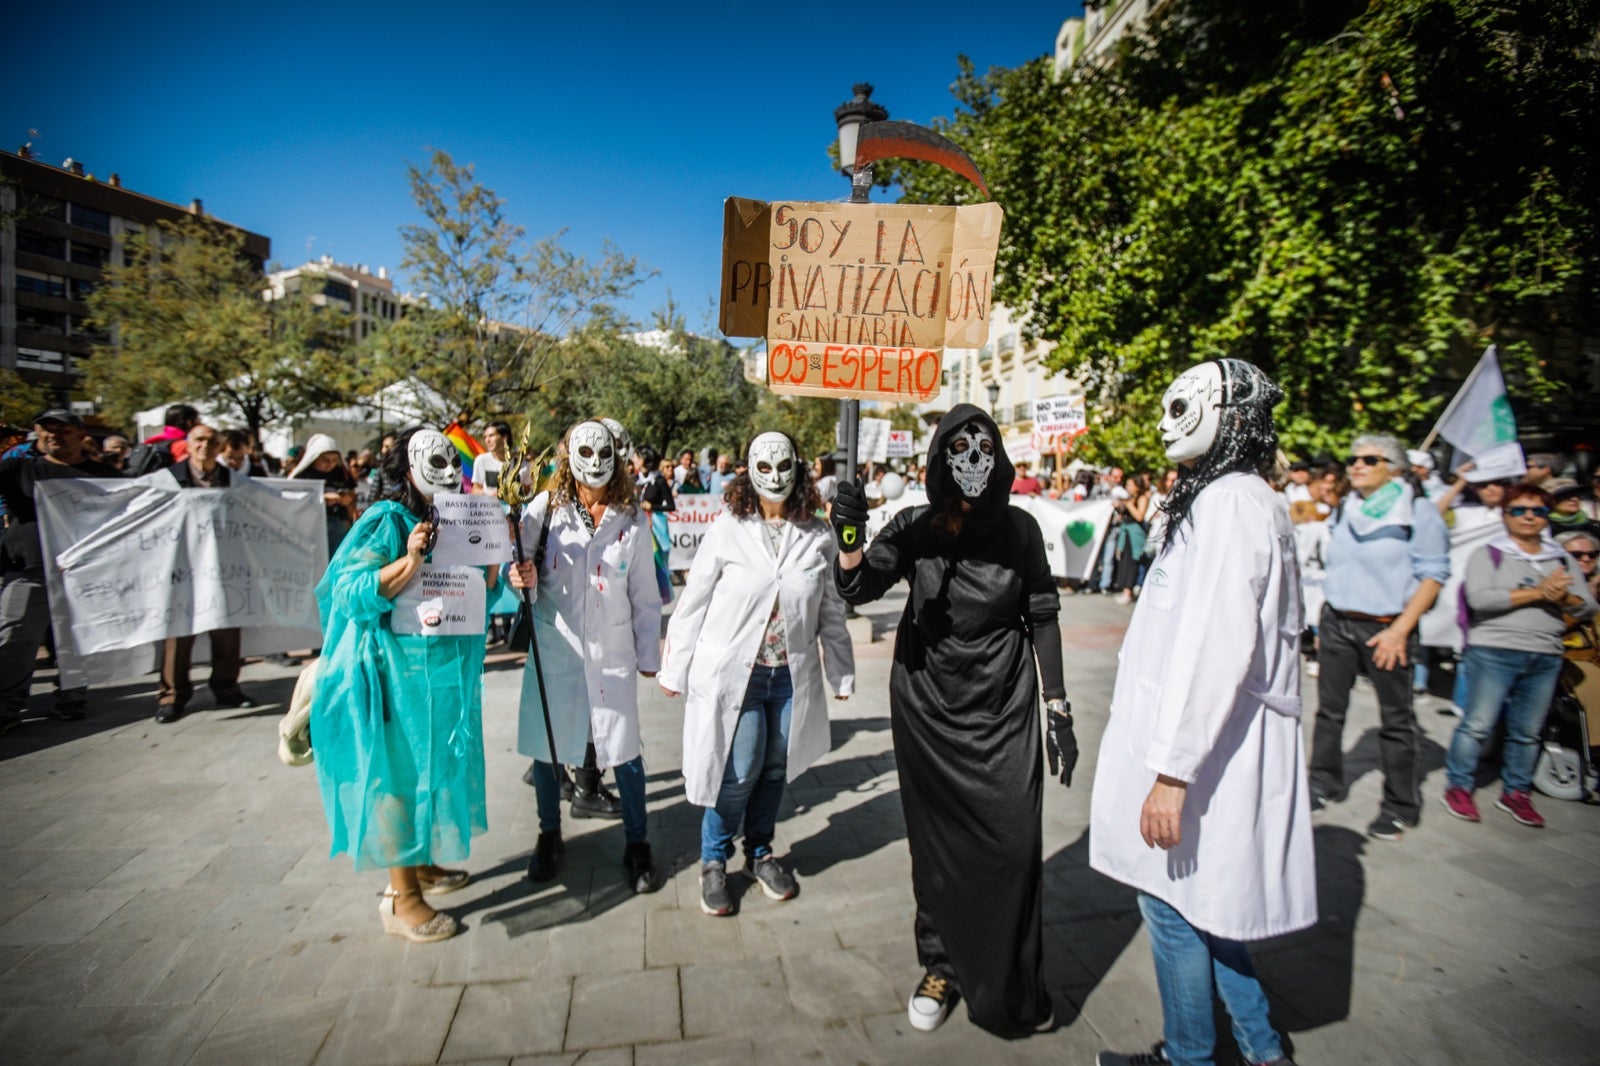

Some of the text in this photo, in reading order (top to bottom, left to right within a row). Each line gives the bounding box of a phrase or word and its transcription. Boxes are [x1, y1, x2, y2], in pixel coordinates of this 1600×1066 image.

[773, 205, 925, 265] SOY LA
[769, 343, 939, 399] OS ESPERO
[1037, 402, 1051, 411] NO
[445, 501, 468, 509] BASTA
[420, 571, 469, 580] INVESTIGACIÓN
